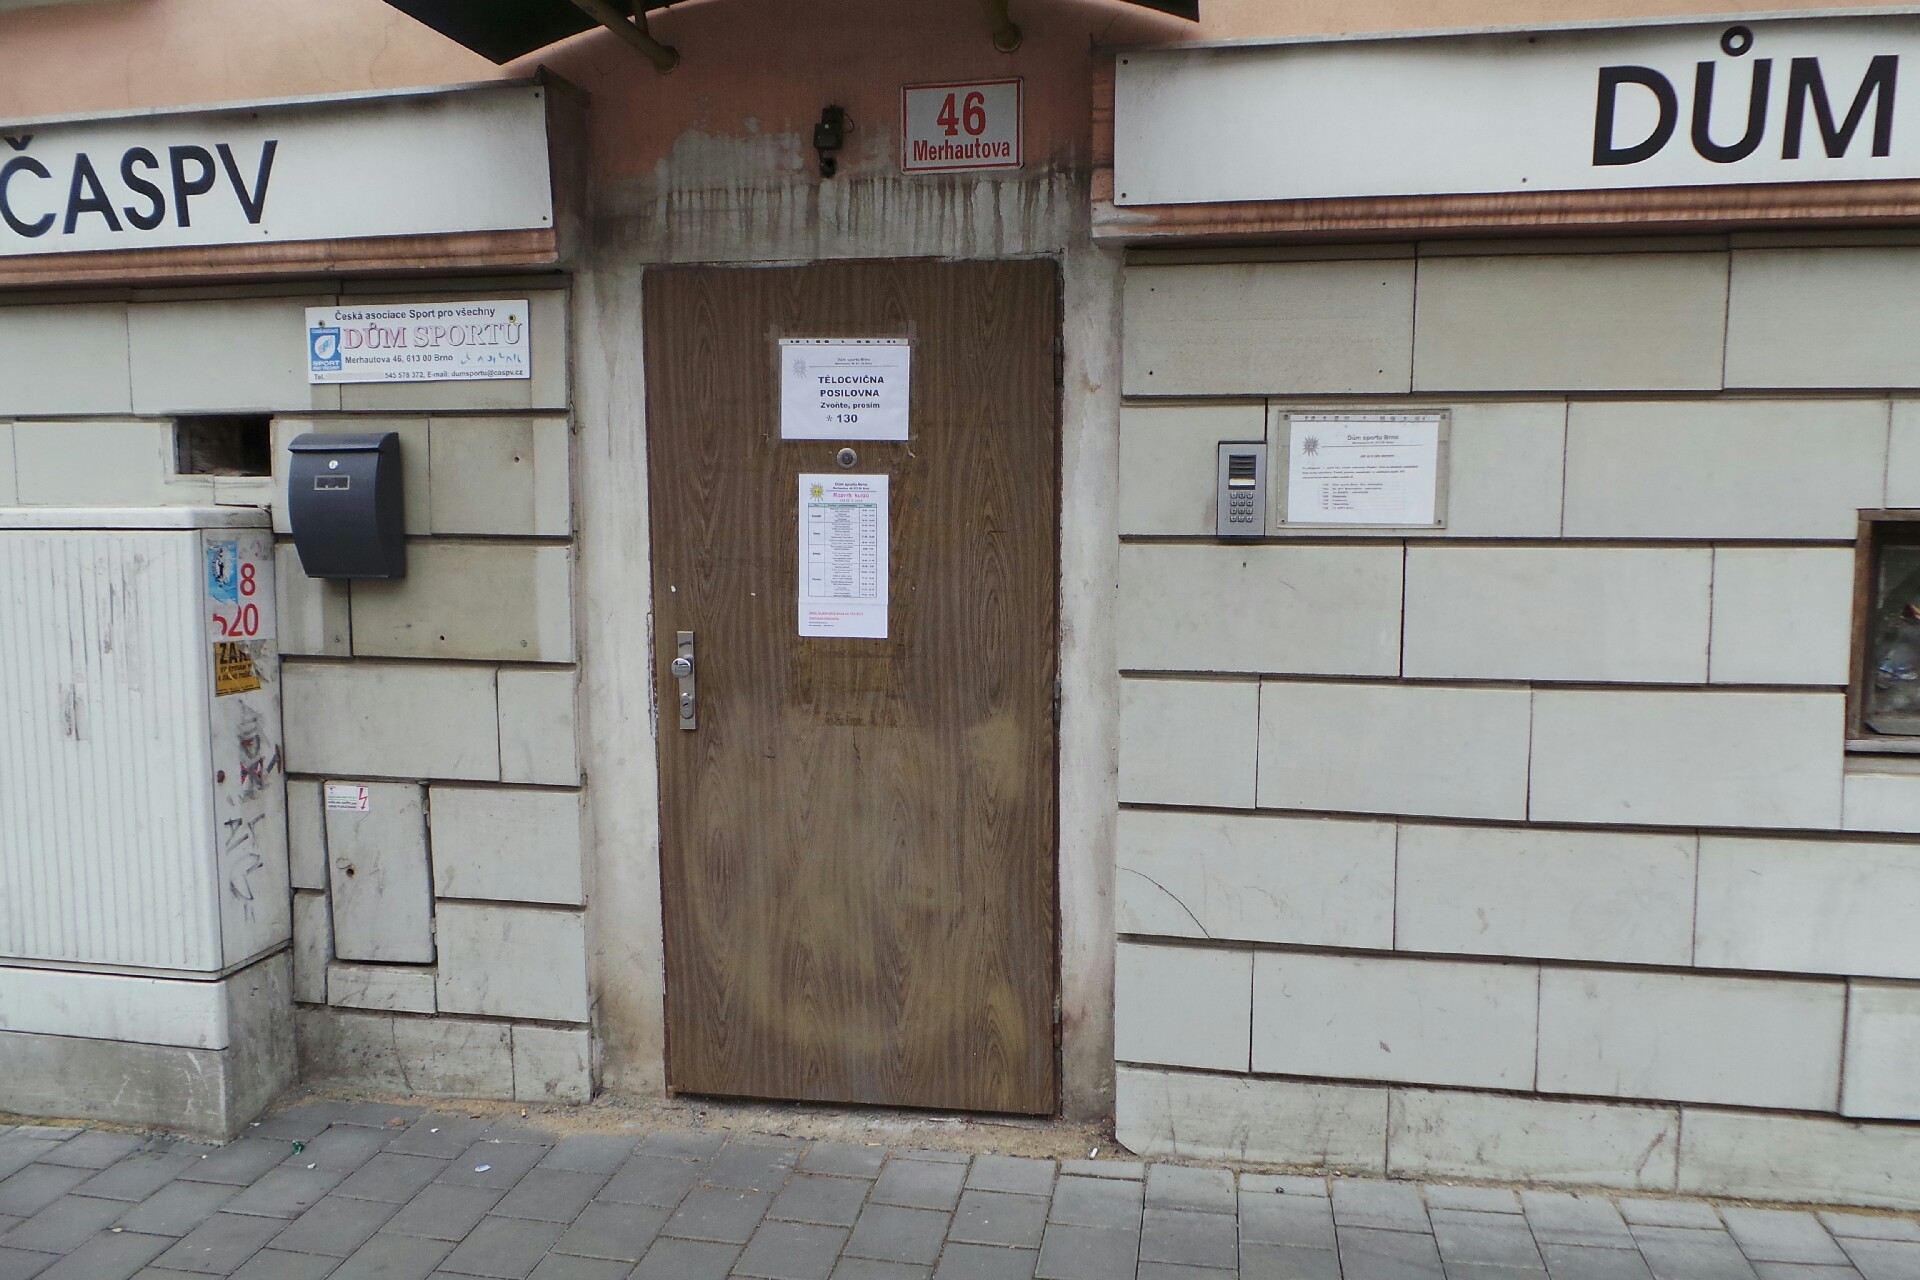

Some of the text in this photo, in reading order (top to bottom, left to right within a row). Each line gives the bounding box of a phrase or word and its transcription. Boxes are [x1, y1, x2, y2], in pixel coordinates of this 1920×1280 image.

[1592, 25, 1899, 166] DŮM
[936, 91, 986, 136] 46
[913, 138, 1010, 161] Merhautova
[0, 134, 278, 238] ČASPV
[335, 307, 496, 321] Česká asociace Sport pro všechny
[344, 322, 407, 350] DŮM
[345, 354, 391, 364] Merhautova
[393, 355, 404, 364] 46,
[406, 354, 421, 363] 613
[423, 353, 432, 363] 00
[434, 353, 454, 362] Brno
[818, 374, 885, 384] TĚLOCVIČNA
[820, 389, 880, 397] POSILOVNA
[853, 401, 880, 409] prosím
[837, 413, 858, 423] 130
[240, 563, 256, 596] 8
